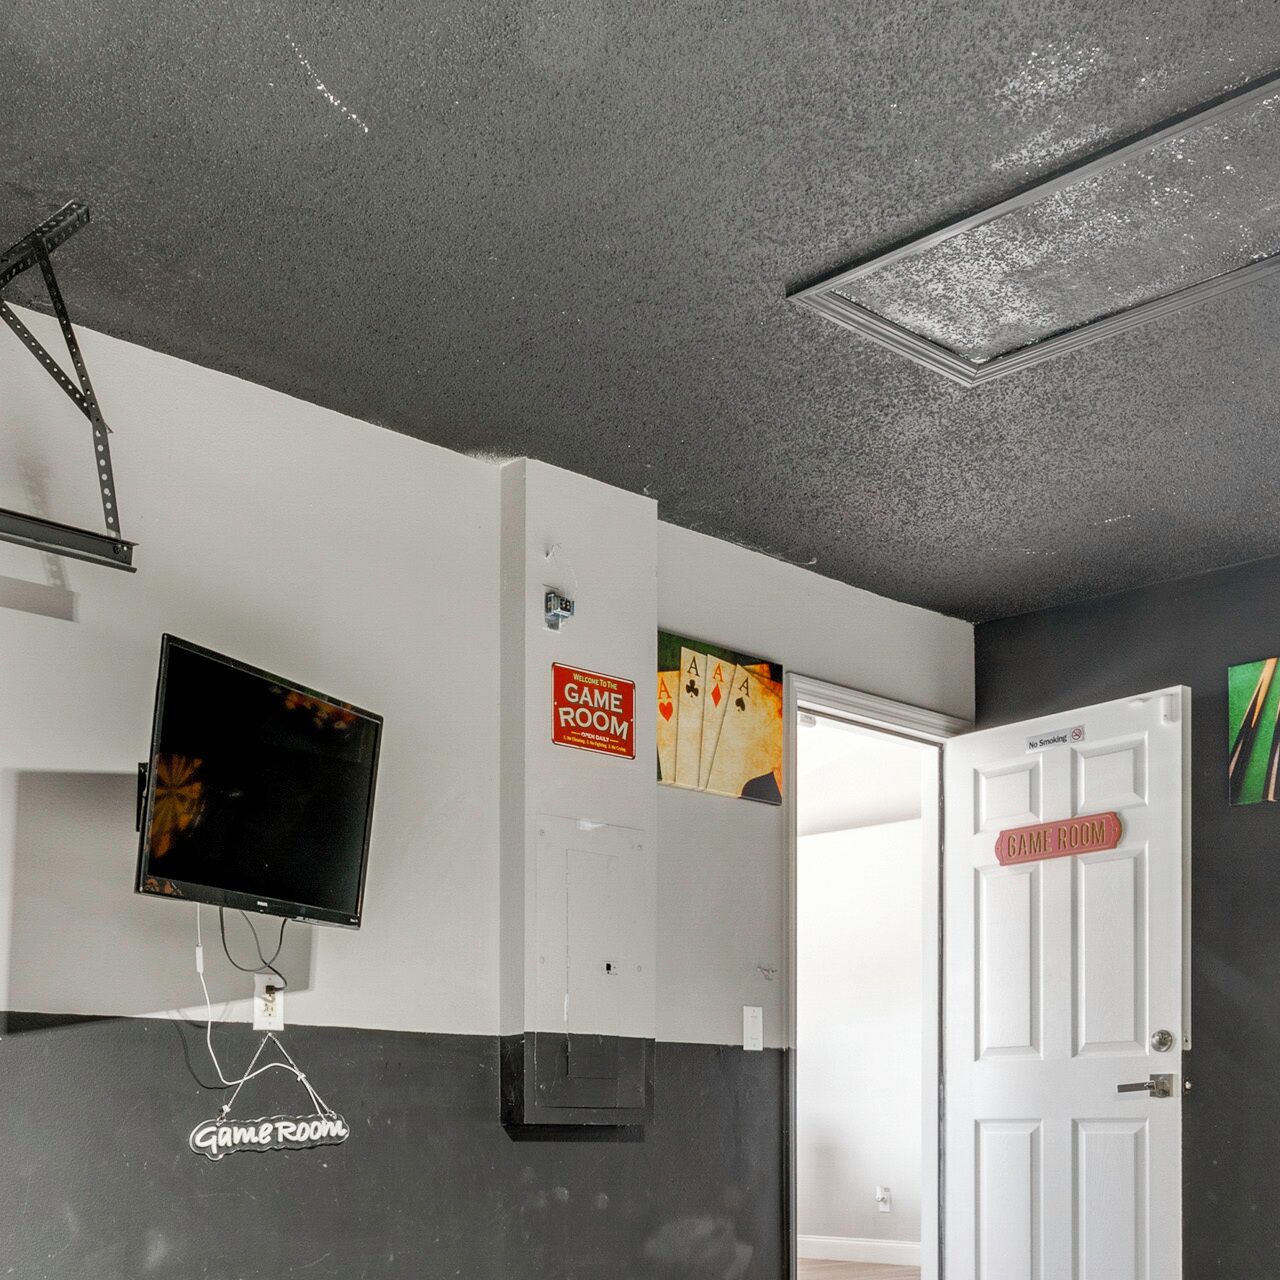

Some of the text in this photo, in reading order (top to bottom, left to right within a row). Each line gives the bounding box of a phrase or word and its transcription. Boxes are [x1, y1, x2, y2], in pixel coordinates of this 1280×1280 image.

[687, 656, 700, 677] A
[713, 663, 723, 682] A
[564, 683, 623, 713] GAME
[658, 677, 672, 699] A
[738, 677, 750, 698] A
[559, 707, 629, 740] ROOM
[595, 734, 610, 743] DAILY
[1029, 734, 1068, 749] No Smoking
[1007, 820, 1107, 858] GAME ROOM
[194, 1120, 348, 1154] Game Room
